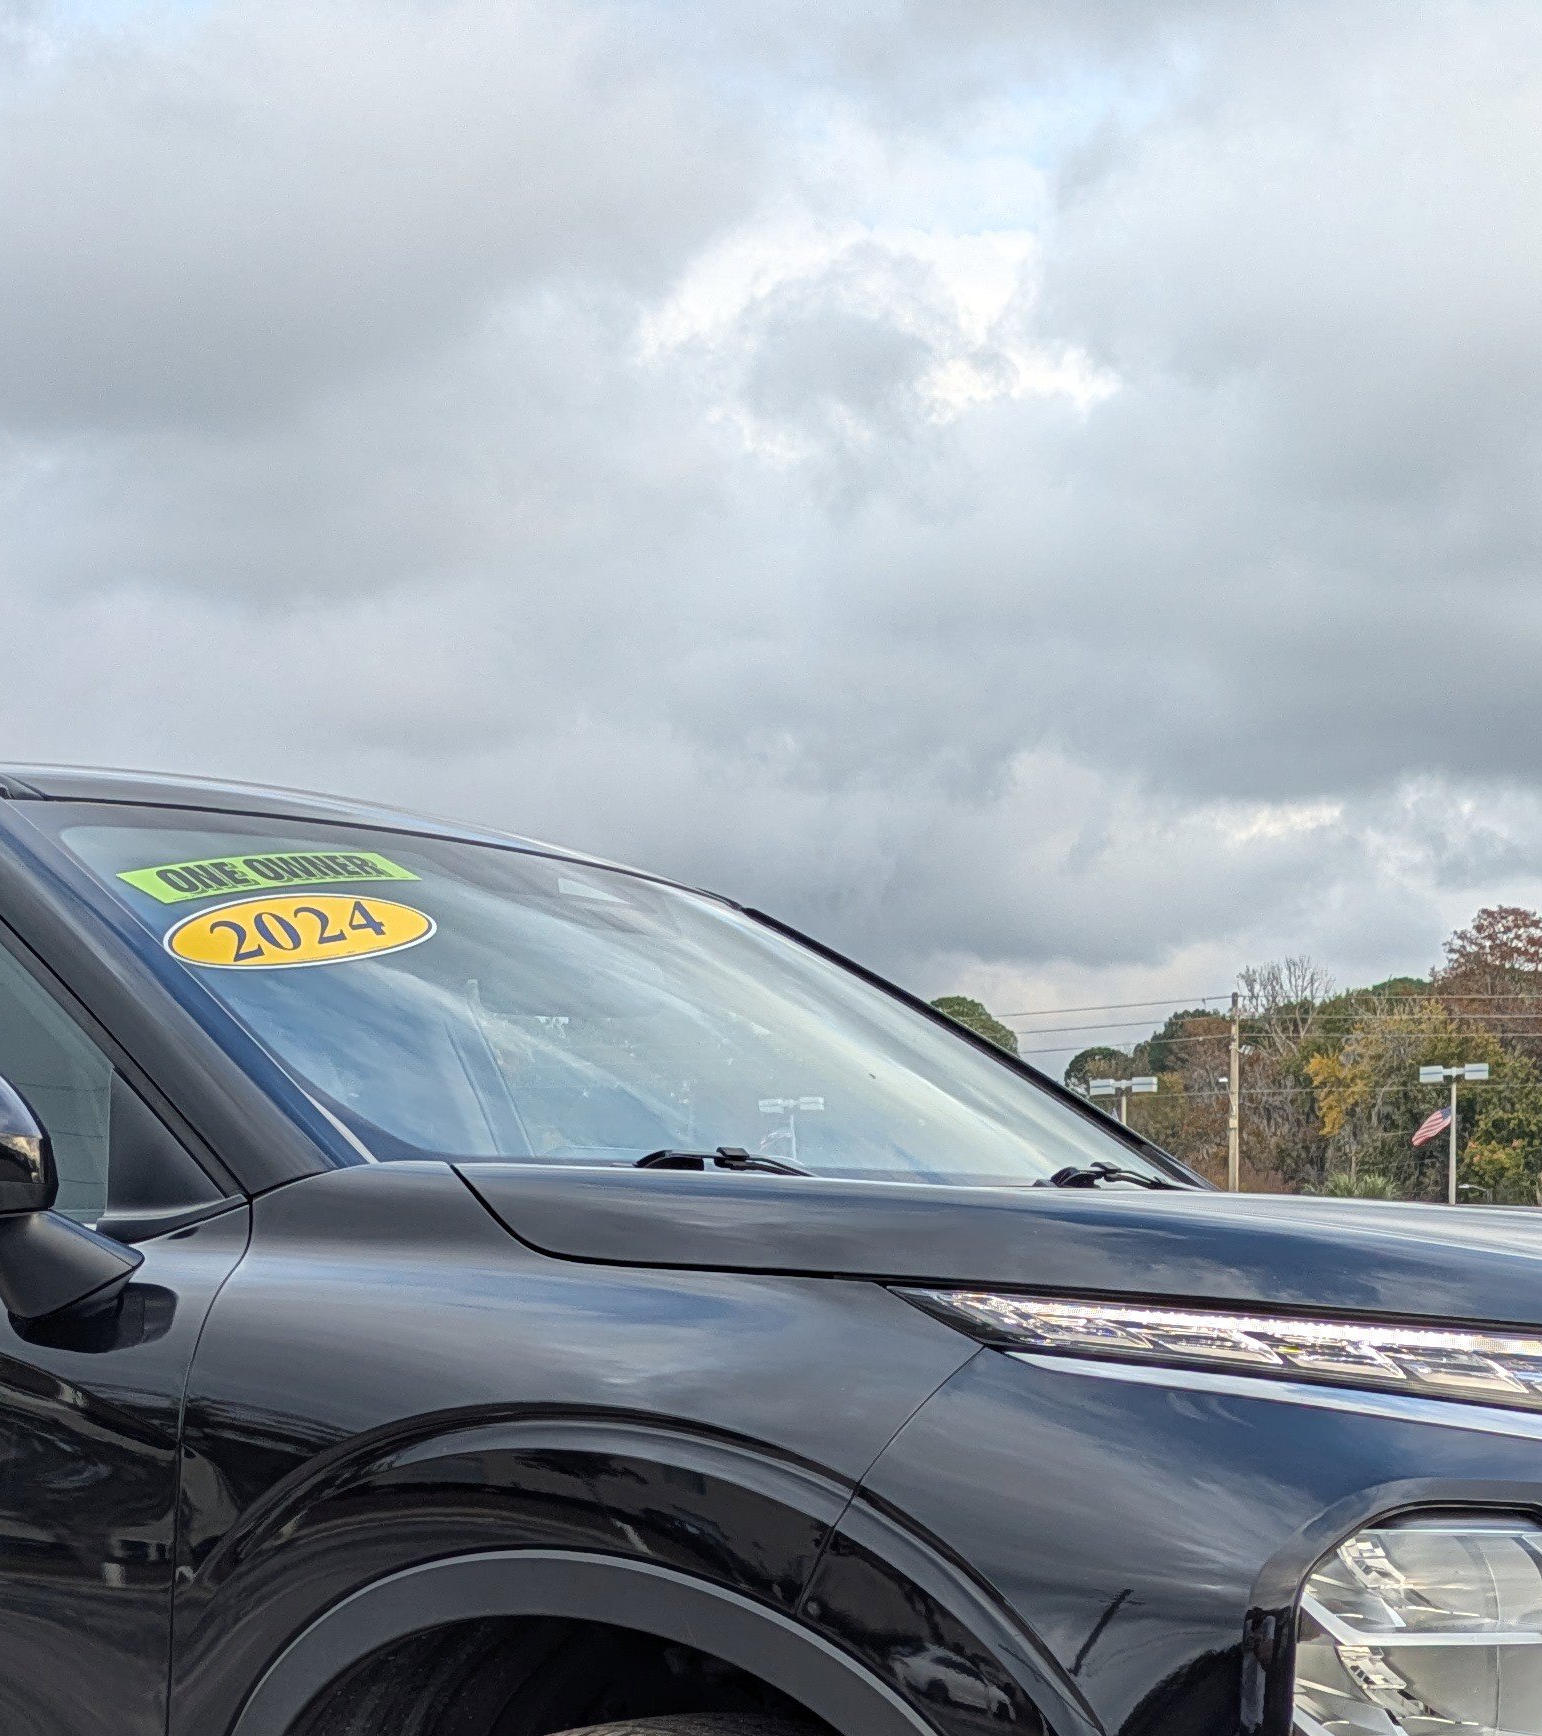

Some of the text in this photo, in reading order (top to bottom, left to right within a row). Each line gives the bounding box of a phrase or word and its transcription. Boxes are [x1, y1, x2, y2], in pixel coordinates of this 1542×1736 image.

[156, 855, 394, 894] ONE OWNER
[209, 901, 386, 963] 2024
